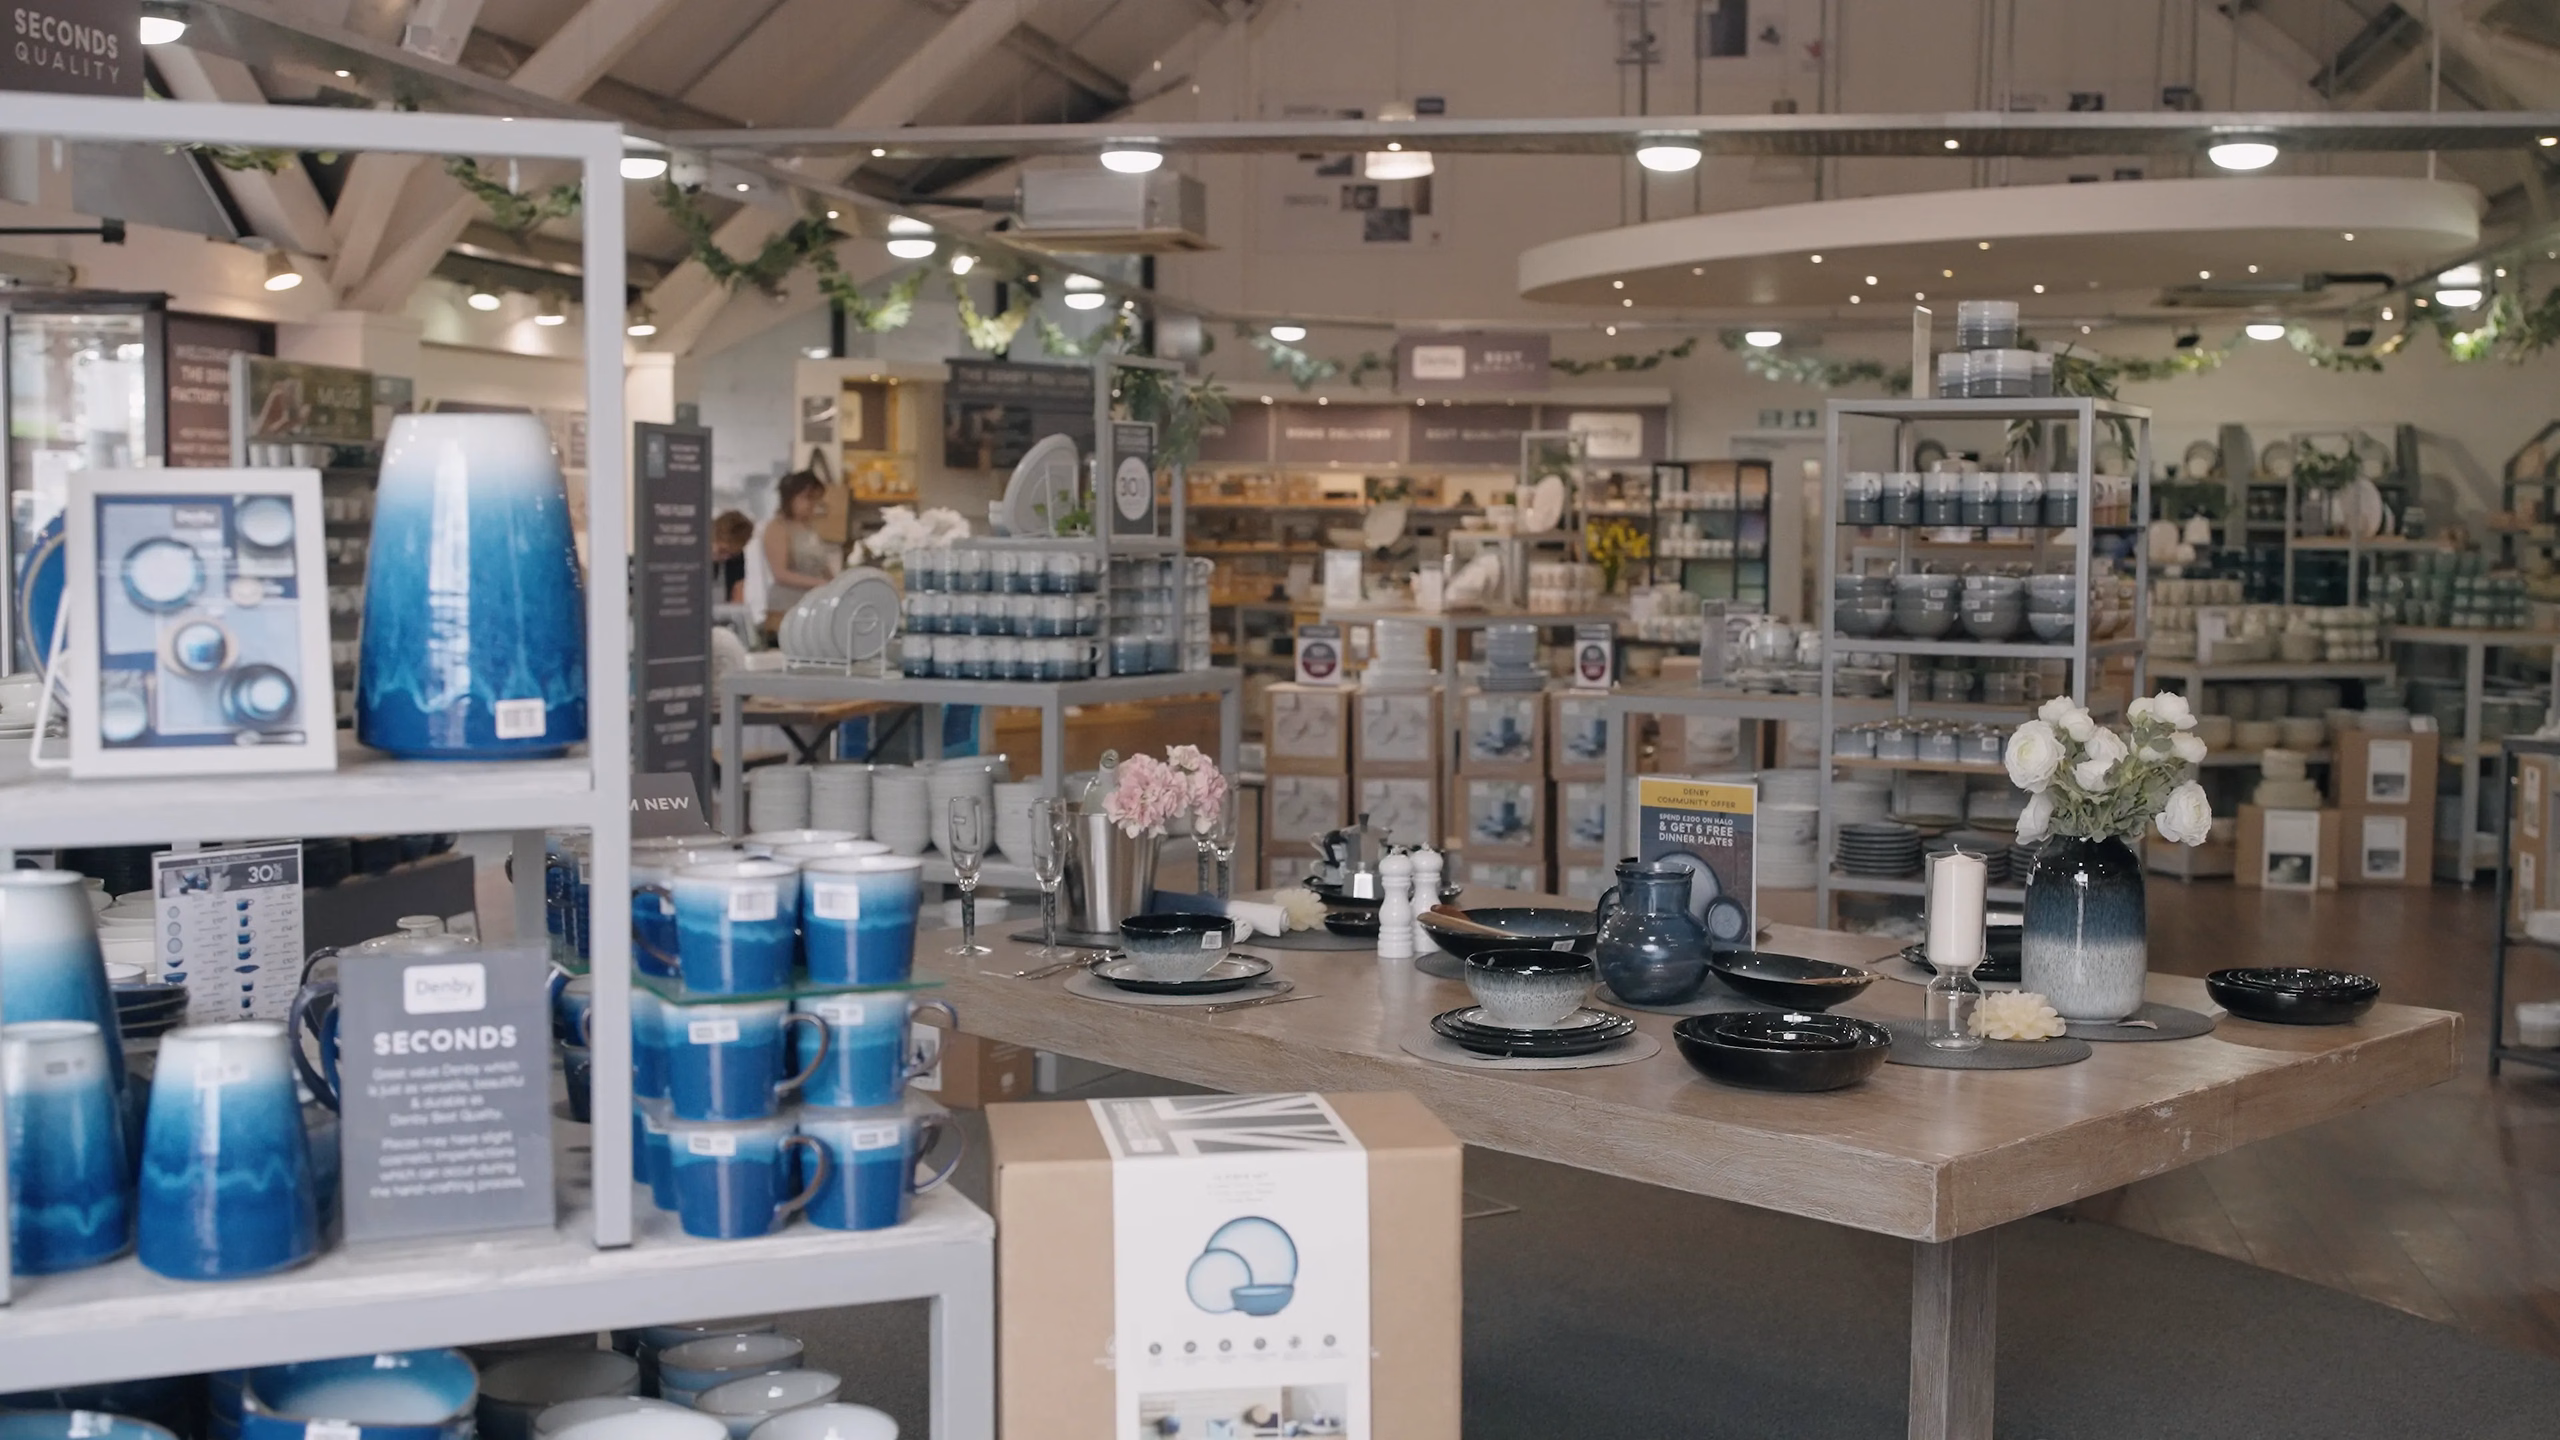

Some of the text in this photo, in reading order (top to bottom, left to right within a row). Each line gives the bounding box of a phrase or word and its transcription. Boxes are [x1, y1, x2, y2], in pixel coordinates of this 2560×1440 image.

[14, 7, 118, 59] SECONDS
[15, 41, 120, 84] QUALITY
[1683, 788, 1709, 797] DENBY
[644, 797, 689, 811] NEW
[1657, 796, 1736, 809] COMMUNITY OFFER
[1659, 813, 1681, 822] SPEND
[1682, 815, 1700, 823] £200
[1714, 818, 1734, 826] HALO
[1659, 821, 1734, 837] & GET 6 FREE
[1659, 832, 1734, 847] DINNER PLATES
[415, 977, 474, 997] Denby
[373, 1024, 518, 1056] SECONDS
